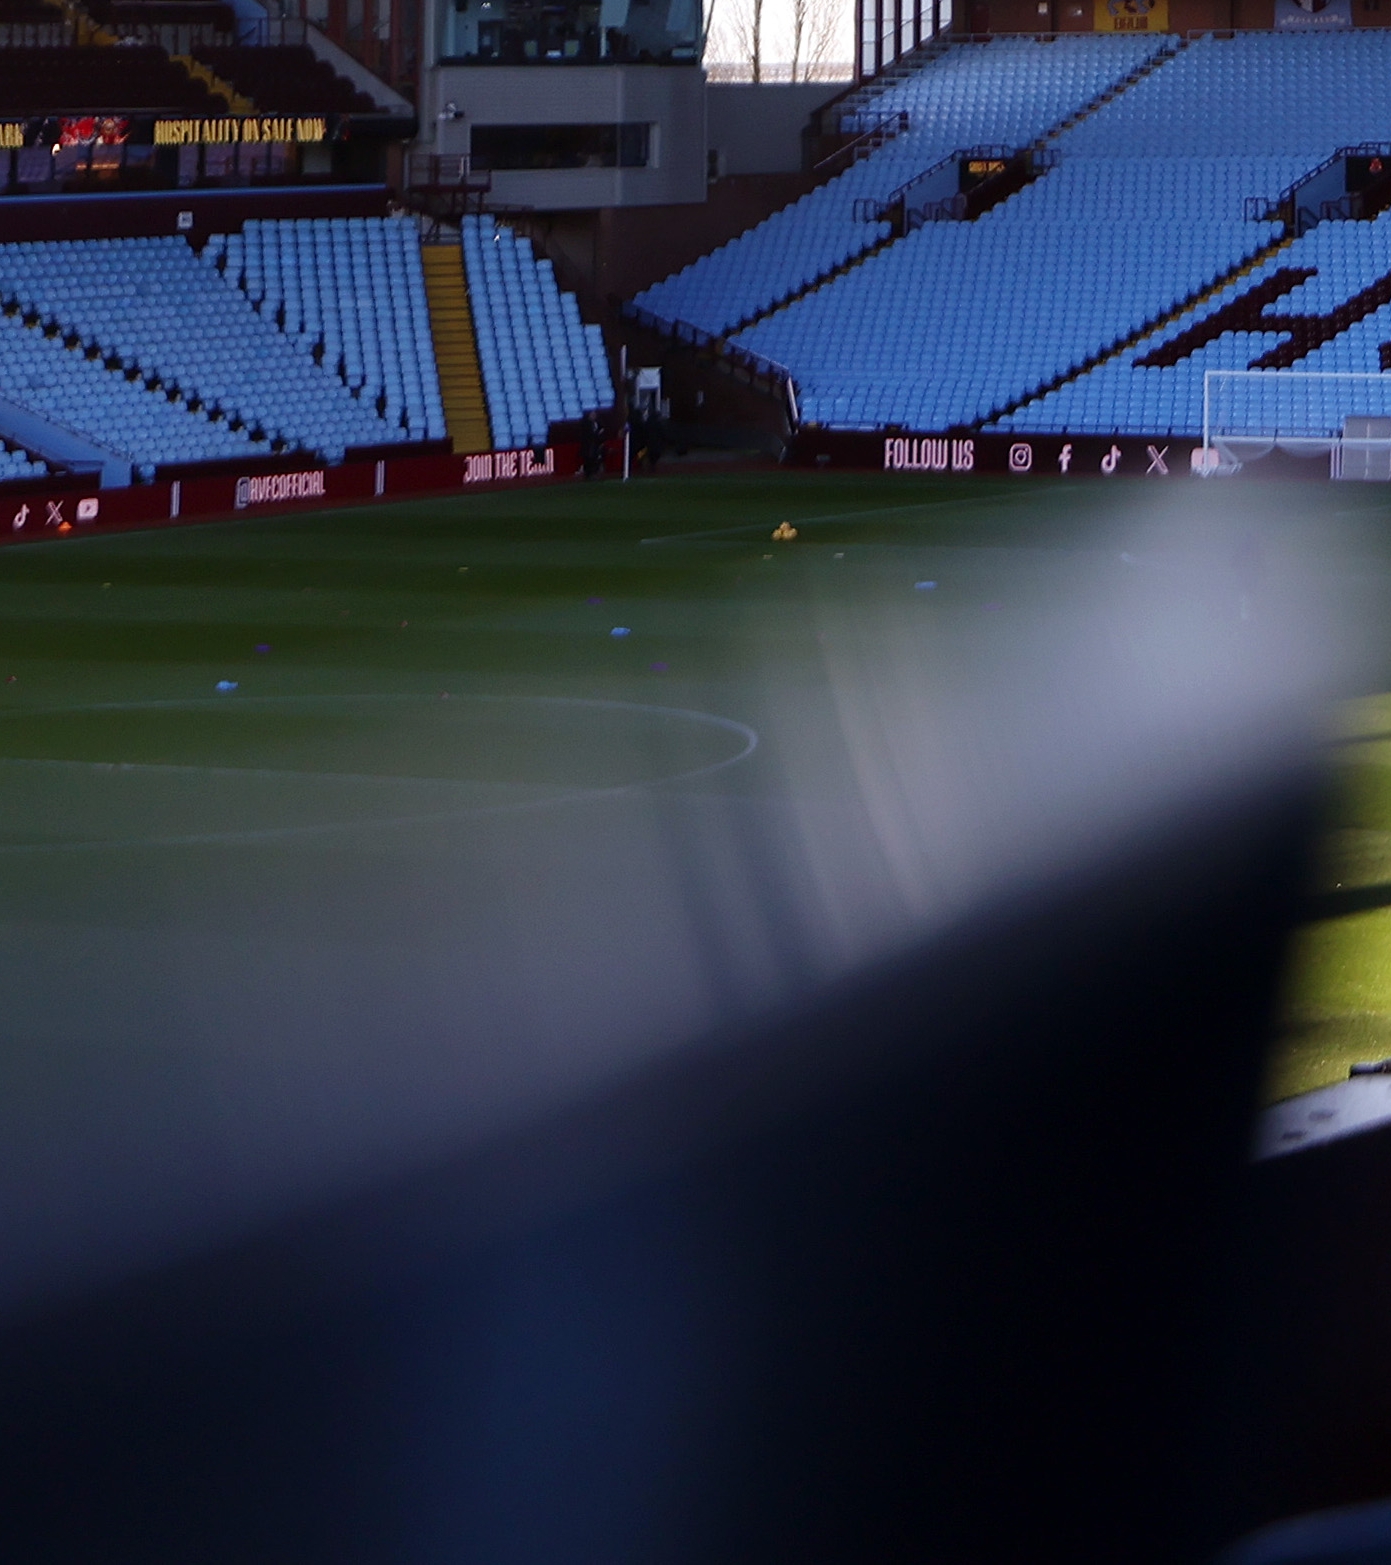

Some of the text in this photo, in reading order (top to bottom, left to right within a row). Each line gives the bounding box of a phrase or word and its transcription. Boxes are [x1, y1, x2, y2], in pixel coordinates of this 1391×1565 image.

[463, 453, 494, 484] JOIN
[494, 451, 518, 480] THE
[884, 437, 950, 472] FOLLOW
[951, 437, 977, 472] US
[234, 470, 327, 510] @AVFCOFFICIAL
